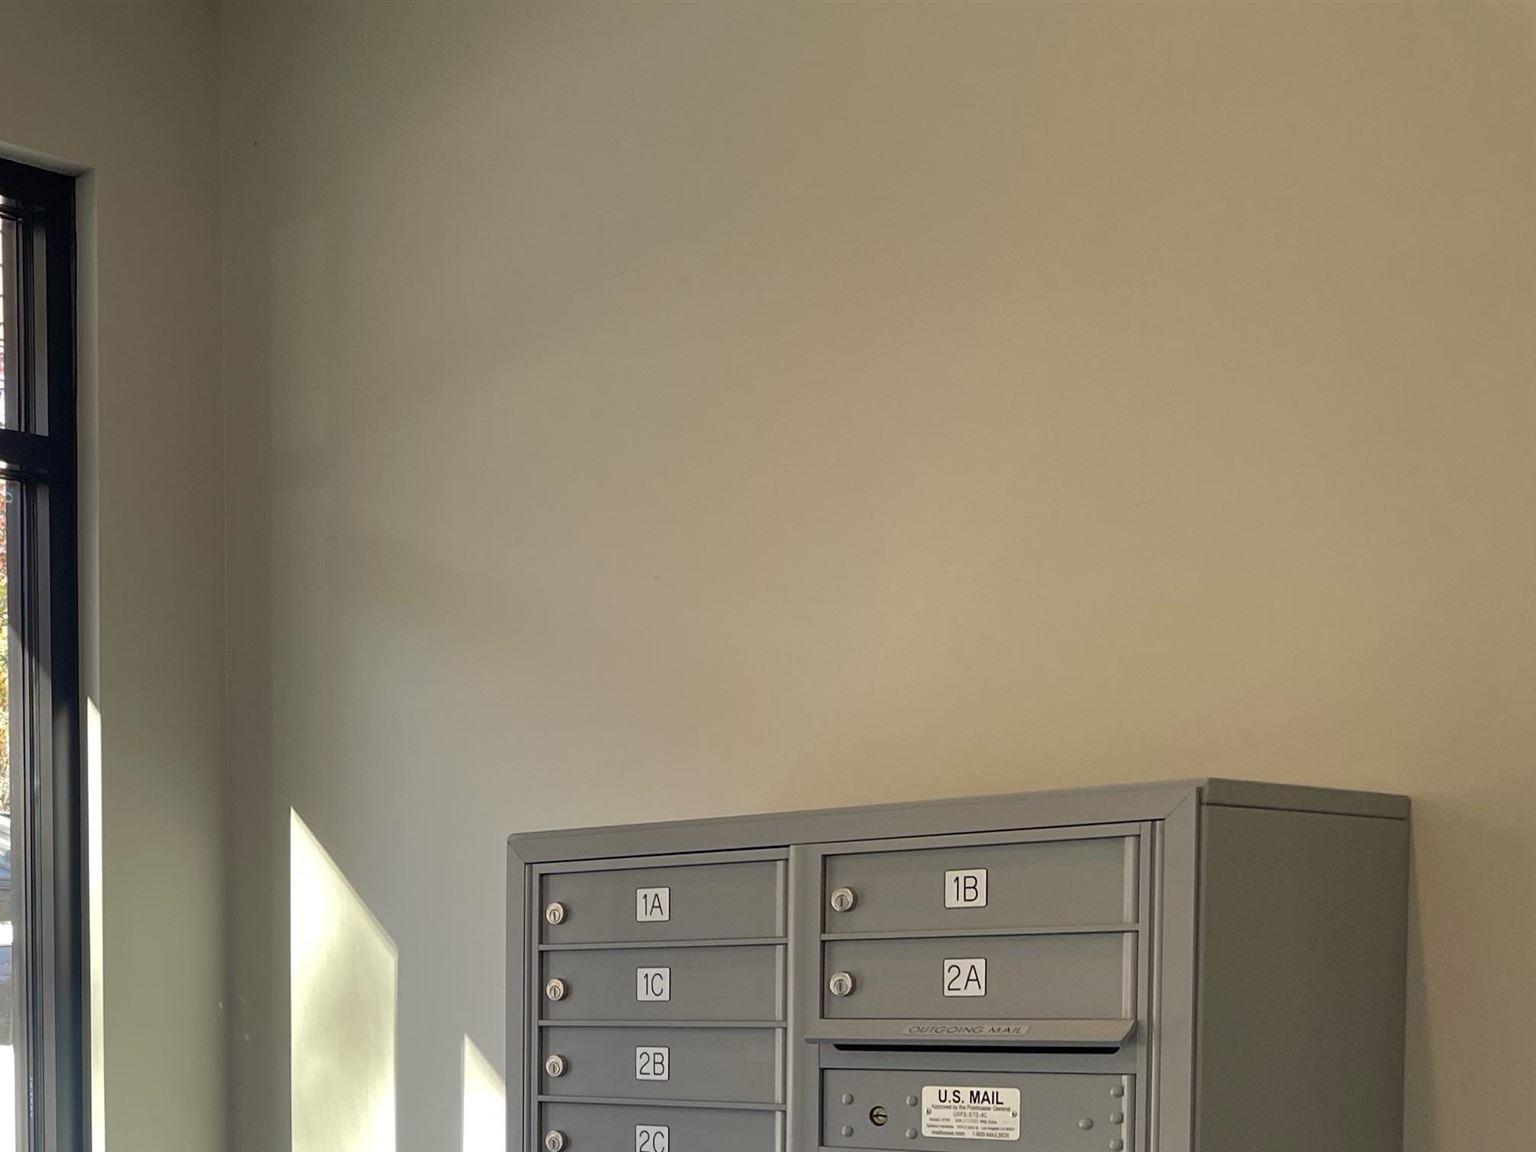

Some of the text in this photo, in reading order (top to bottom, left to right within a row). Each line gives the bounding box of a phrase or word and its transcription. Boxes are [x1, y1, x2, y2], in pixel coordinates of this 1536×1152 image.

[953, 875, 979, 902] 1B
[642, 893, 664, 917] 1A
[643, 972, 664, 997] 1C
[947, 964, 982, 992] 2A
[908, 1025, 1022, 1034] OUTGOING MAIL
[639, 1051, 665, 1076] 2B
[938, 1089, 1004, 1105] U.S. MAIL
